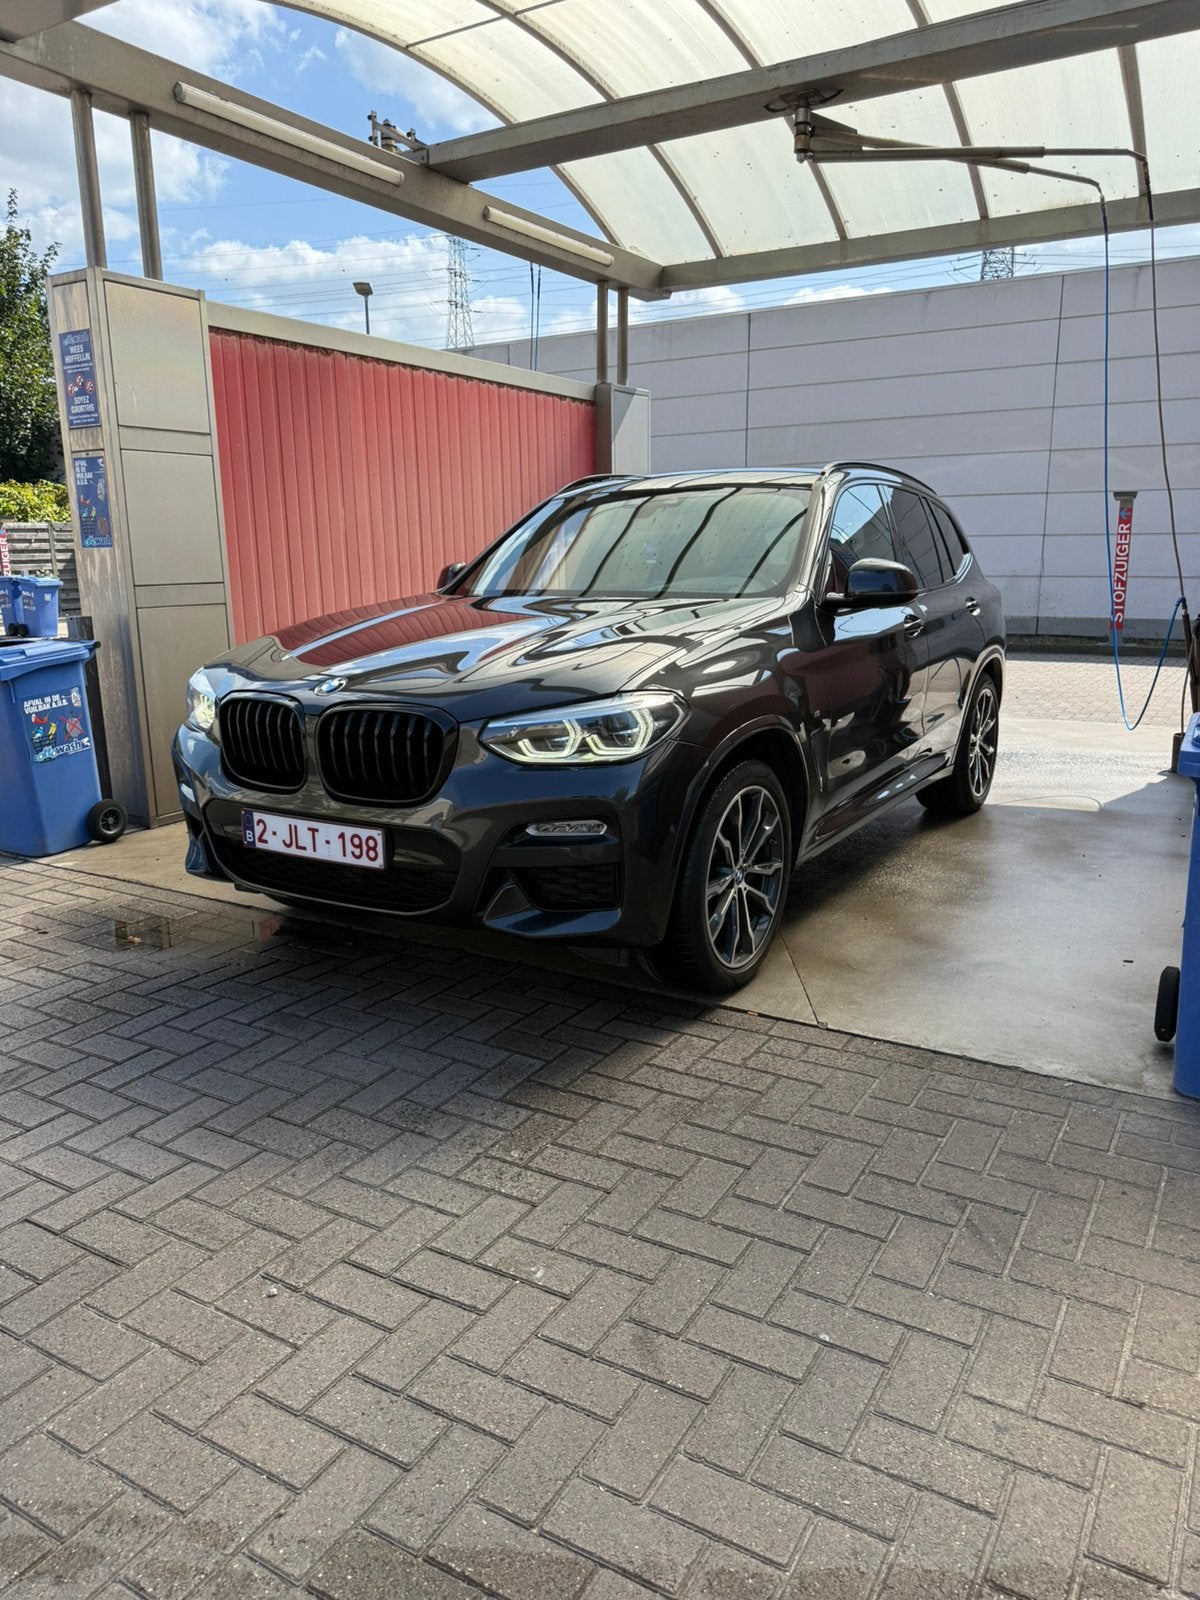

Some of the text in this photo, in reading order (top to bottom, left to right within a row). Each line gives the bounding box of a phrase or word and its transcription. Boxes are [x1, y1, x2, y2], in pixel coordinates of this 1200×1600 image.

[69, 344, 83, 354] WEES
[1112, 522, 1131, 623] STOFZUIGER
[24, 698, 43, 709] AFVAL
[52, 694, 60, 702] DE
[24, 702, 51, 714] VUILBAK
[246, 830, 254, 842] B
